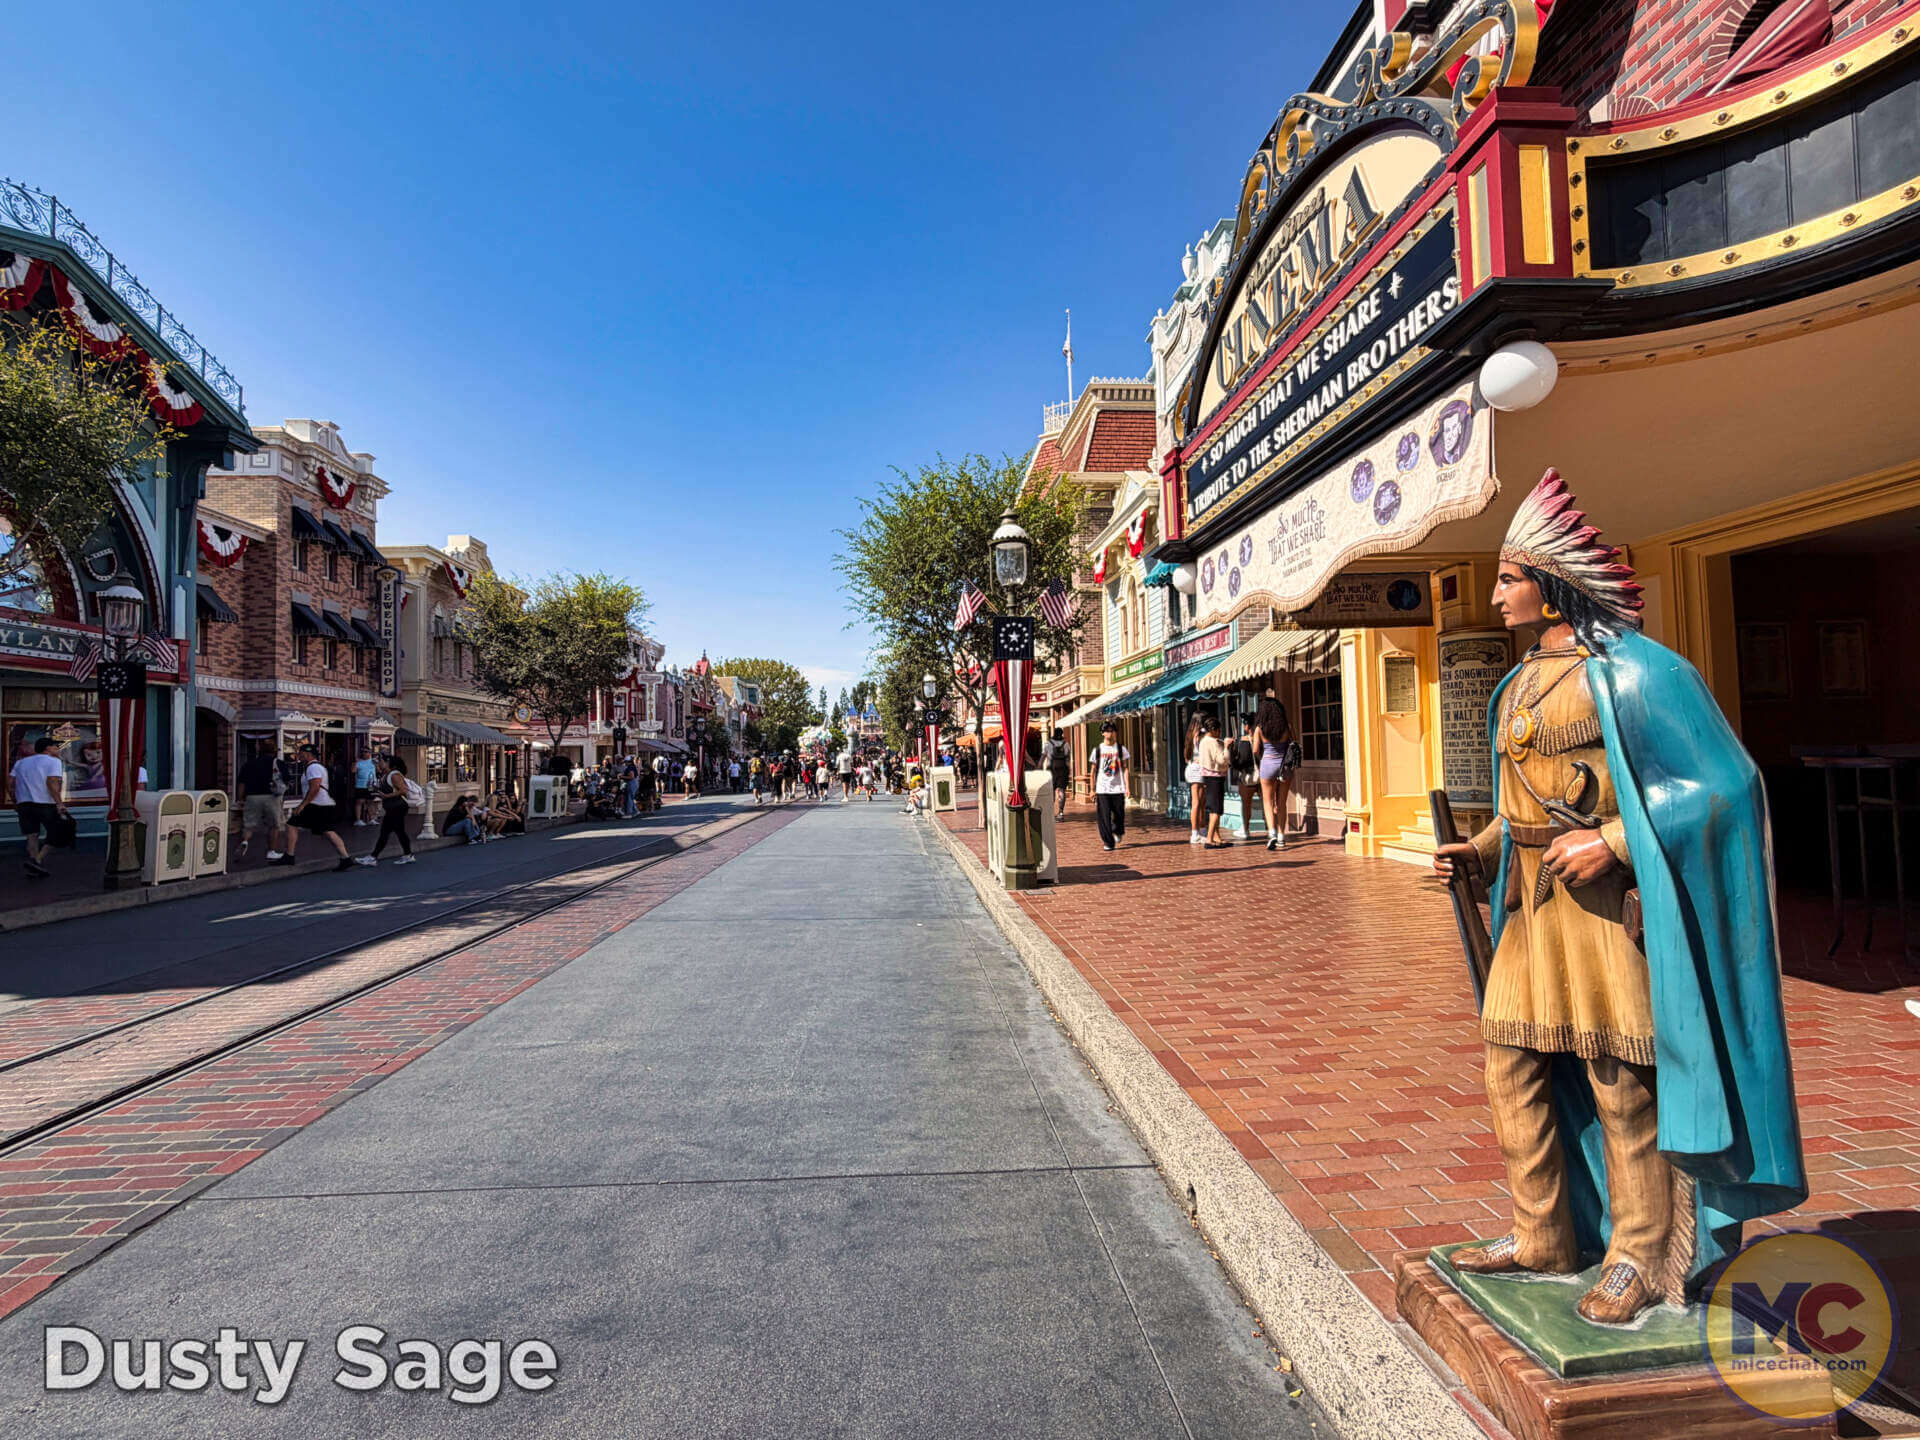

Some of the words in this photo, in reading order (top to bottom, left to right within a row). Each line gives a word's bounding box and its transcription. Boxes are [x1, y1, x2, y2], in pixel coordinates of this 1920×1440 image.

[1215, 164, 1385, 392] CINEMA
[1280, 186, 1326, 254] Street
[1187, 503, 1196, 520] A
[1194, 470, 1230, 515] TRIBUTE
[1230, 457, 1248, 484] TO
[1248, 435, 1272, 469] THE
[1273, 373, 1344, 451] SHERMAN
[1347, 276, 1460, 391] BROTHERS
[1210, 441, 1224, 467] SO
[1225, 406, 1257, 454] MUCH
[1258, 371, 1294, 421] THAT
[1296, 346, 1321, 385] WE
[1323, 287, 1382, 362] SHARE
[1287, 532, 1299, 553] WE
[1299, 509, 1327, 546] SHARE
[383, 650, 393, 686] SHOP
